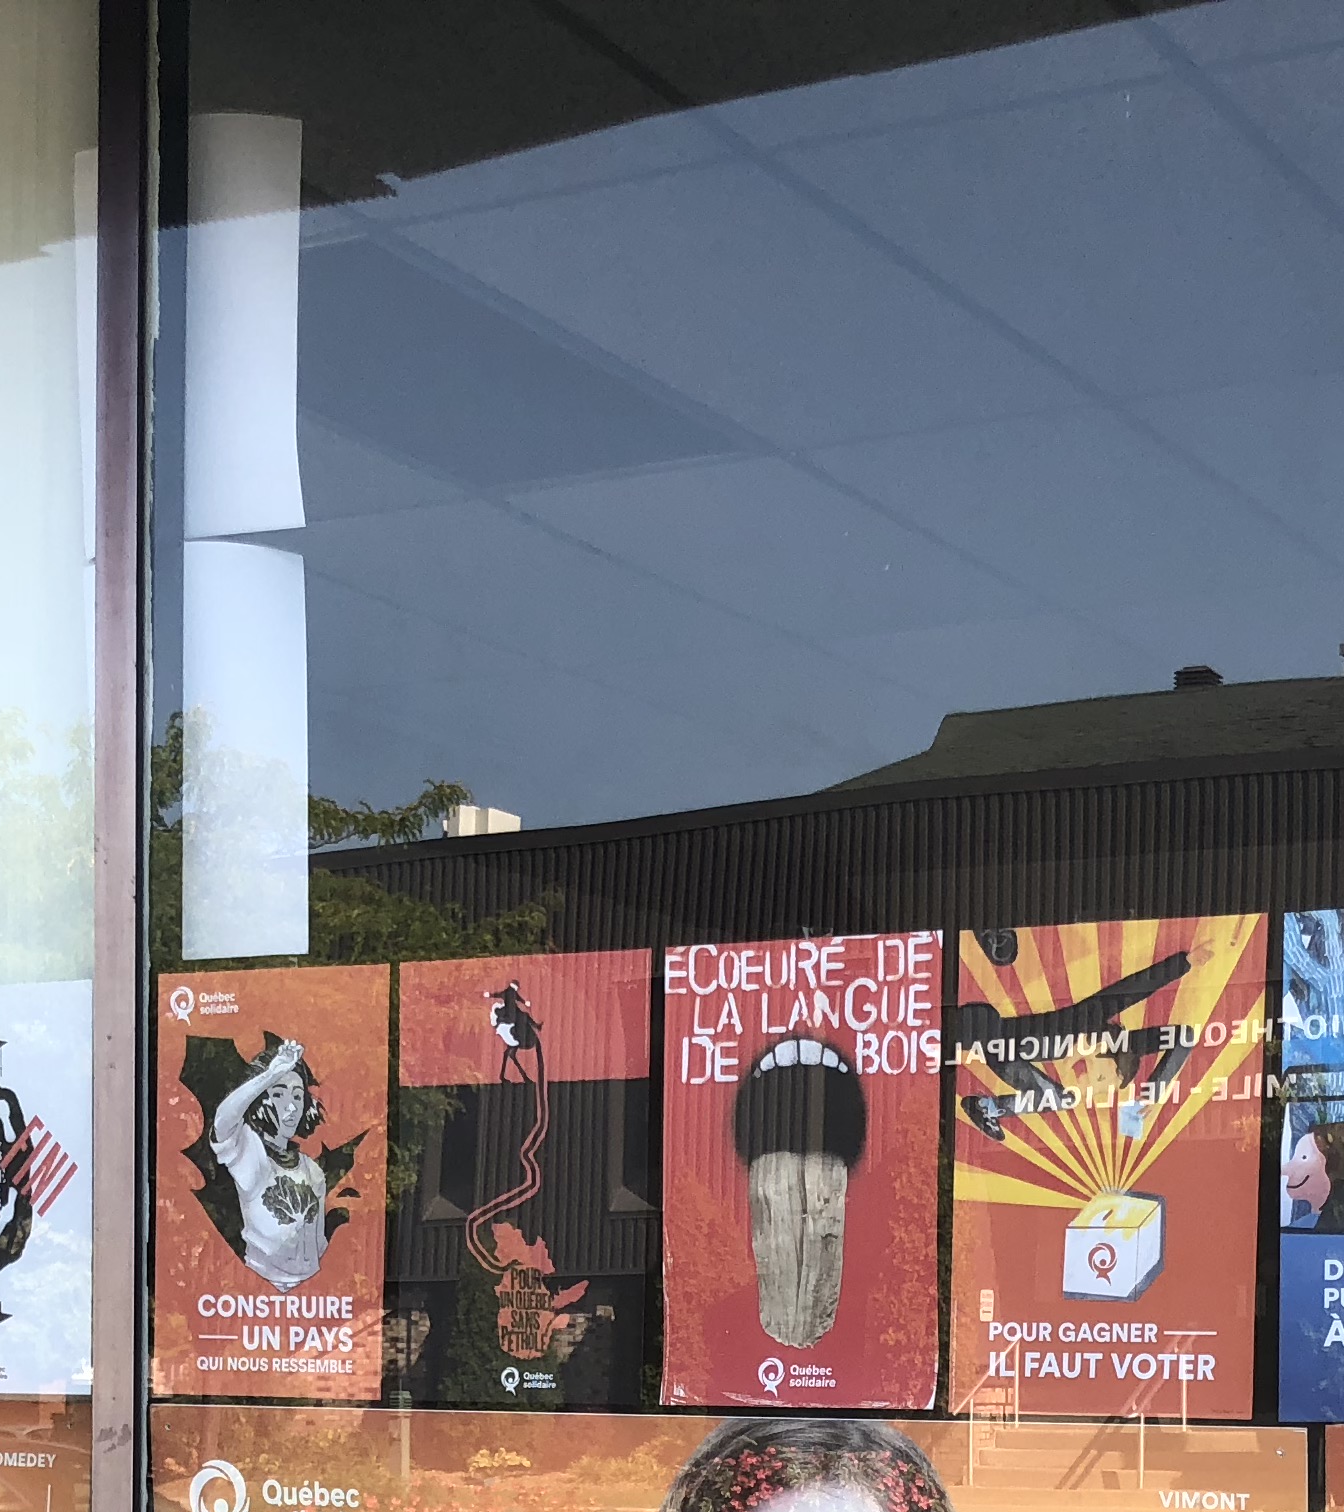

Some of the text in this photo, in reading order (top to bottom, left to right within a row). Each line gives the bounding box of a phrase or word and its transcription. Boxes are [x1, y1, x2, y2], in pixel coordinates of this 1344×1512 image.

[877, 937, 934, 982] DE
[199, 992, 235, 1003] Québec
[693, 978, 933, 1035] LA LANGUE
[681, 1029, 942, 1085] DE BOIS
[0, 1115, 78, 1217] FINI
[511, 1267, 542, 1290] POUR
[197, 1294, 353, 1319] CONSTRUIRE
[511, 1310, 540, 1331] SANS
[989, 1321, 1158, 1343] POUR GAGNER
[242, 1325, 353, 1353] UN PAYS
[196, 1356, 353, 1373] QUI NOUS RESSEMBLE
[790, 1364, 833, 1376] Québec
[989, 1351, 1216, 1381] IL FAUT VOTER
[789, 1376, 836, 1388] solidaire
[262, 1479, 359, 1507] Québec
[1159, 1490, 1250, 1511] VIMONT
